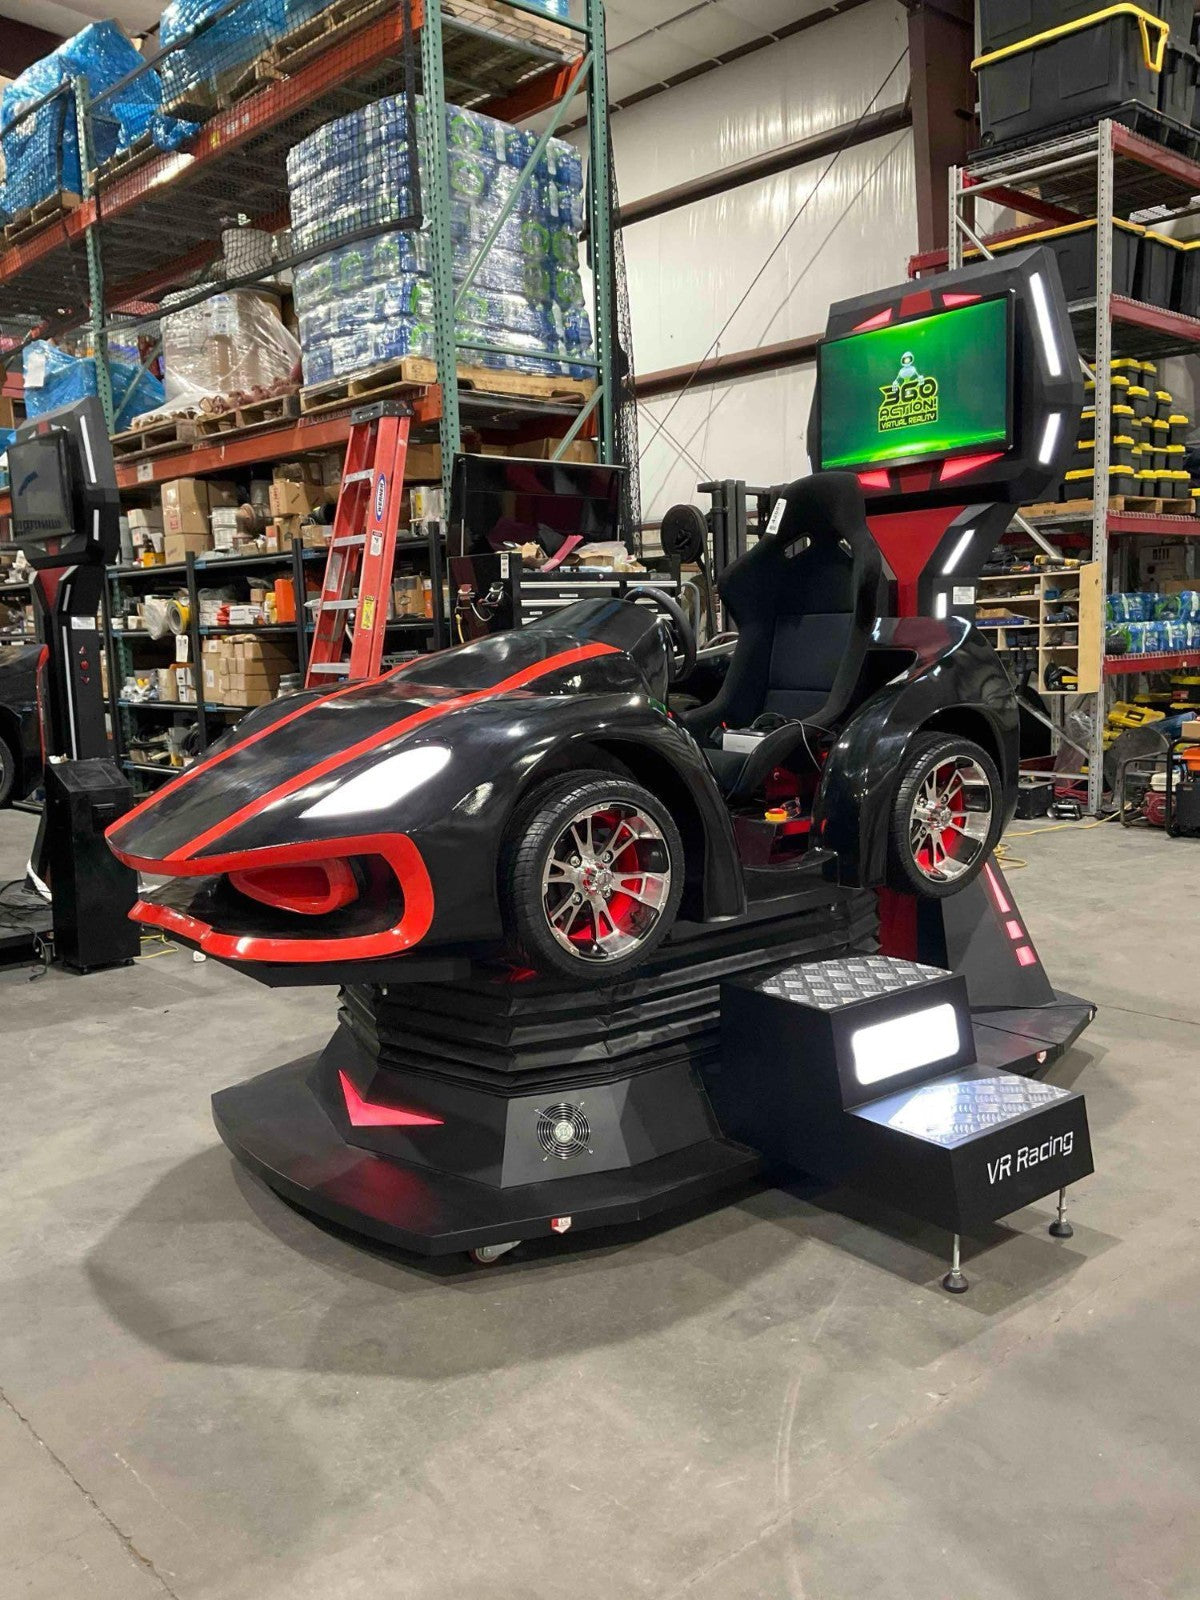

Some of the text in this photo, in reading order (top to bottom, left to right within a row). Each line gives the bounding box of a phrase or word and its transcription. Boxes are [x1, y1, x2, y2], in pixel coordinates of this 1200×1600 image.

[879, 377, 938, 407] 360
[880, 398, 937, 419] ACTION!
[881, 413, 935, 429] VIRTUAL REALITY
[987, 1131, 1074, 1185] VR Racing
